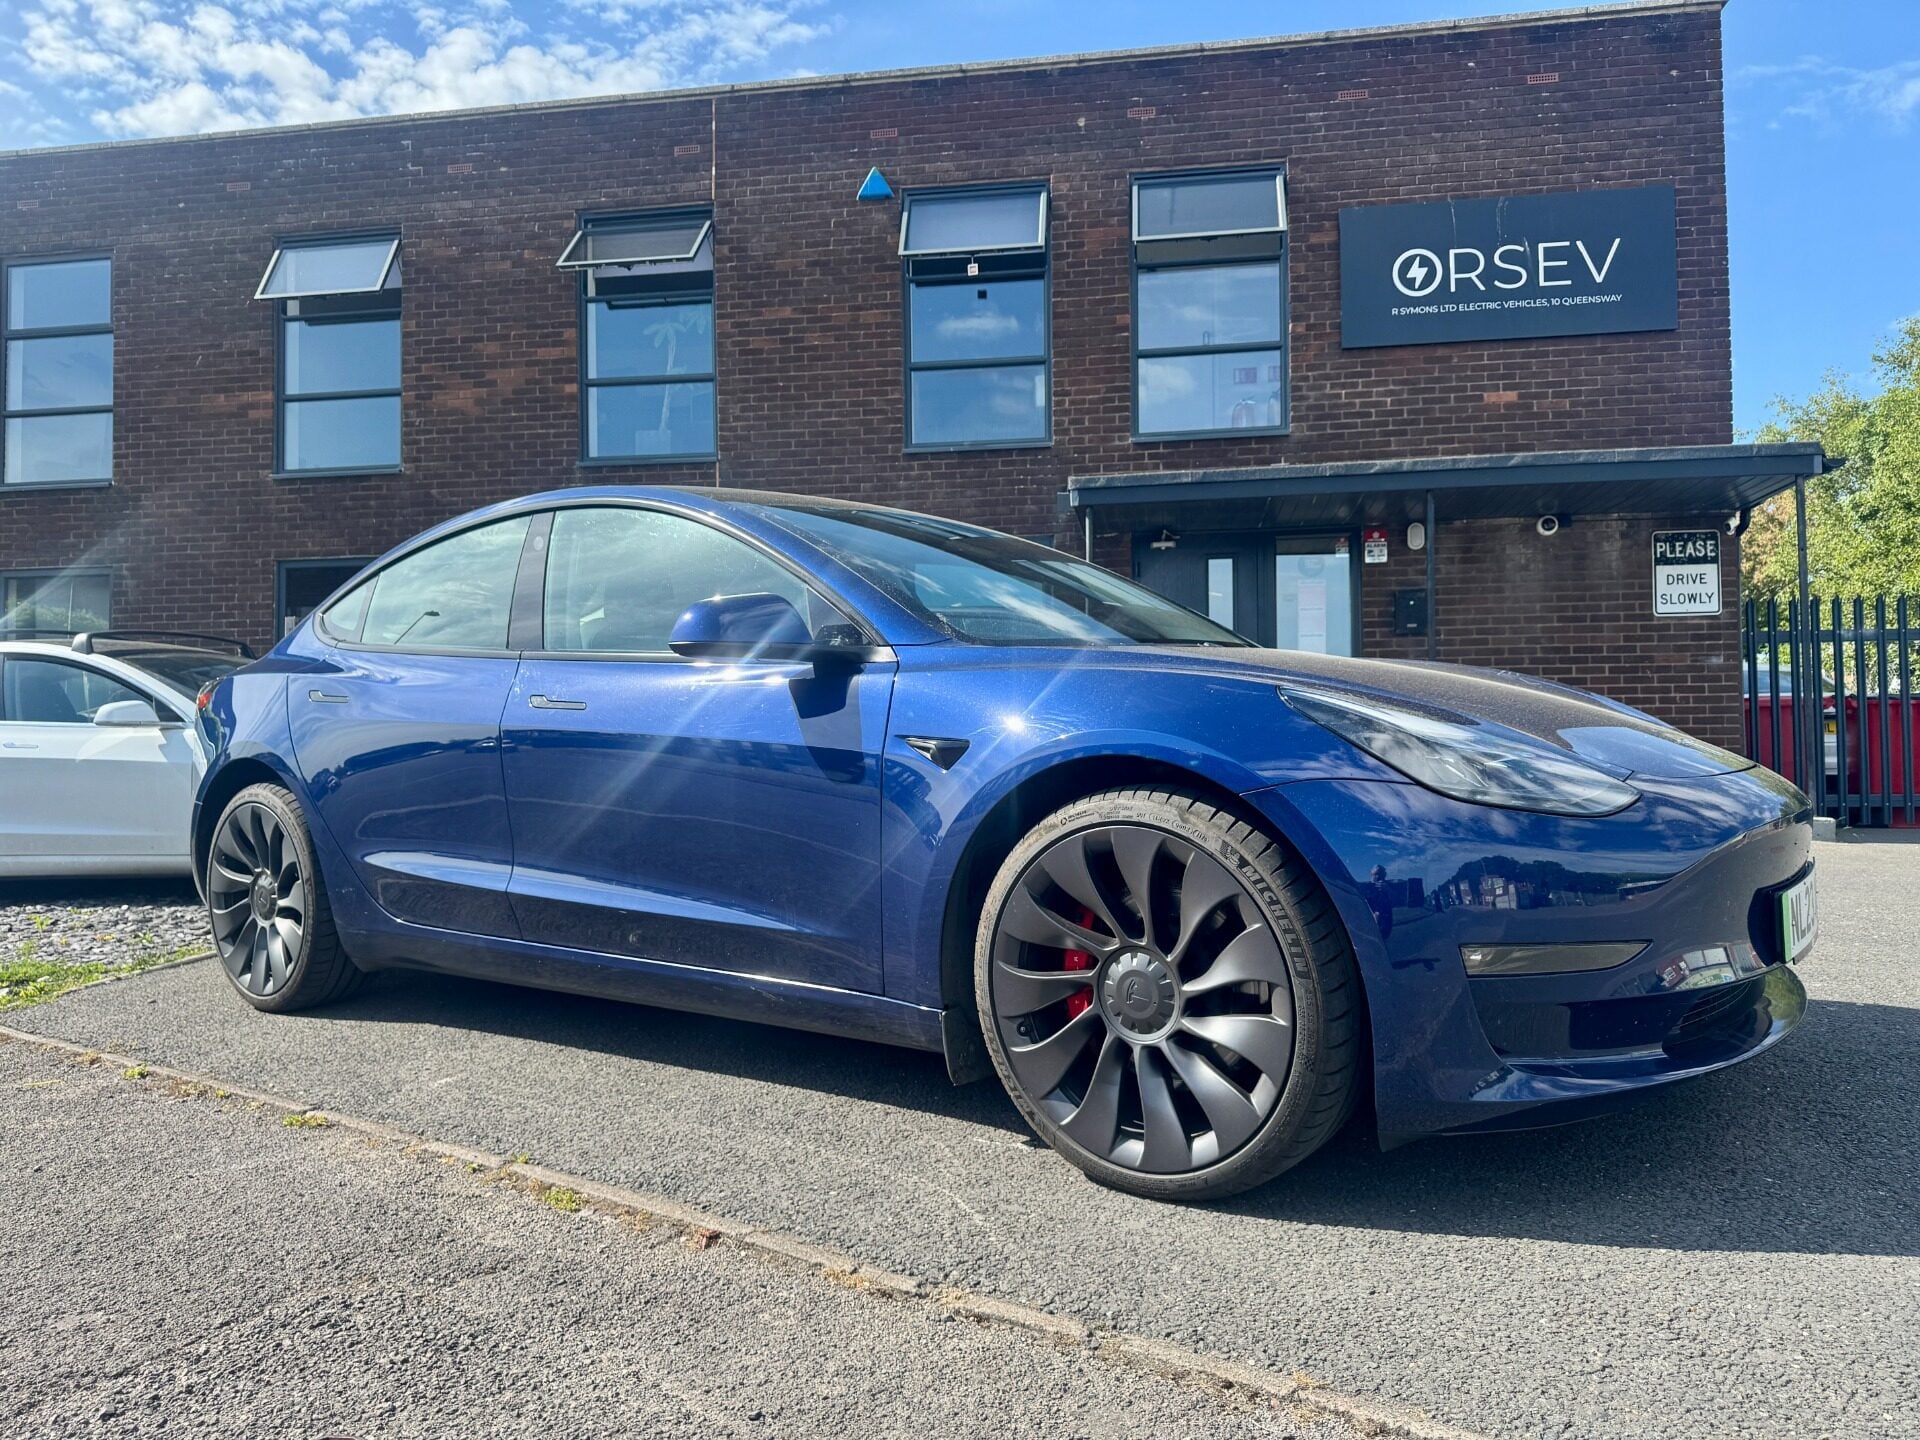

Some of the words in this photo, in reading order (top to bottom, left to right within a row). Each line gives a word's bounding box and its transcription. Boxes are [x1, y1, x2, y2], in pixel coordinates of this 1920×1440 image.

[1391, 307, 1399, 316] R
[1400, 305, 1439, 315] SYMONS
[1440, 303, 1457, 313] LTD
[1459, 301, 1502, 311] ELECTRIC
[1503, 298, 1550, 309] VEHICLES,
[1551, 298, 1561, 306] 10
[1562, 294, 1623, 306] QUEENSWAY
[1656, 540, 1716, 558] PLEASE
[1666, 573, 1708, 586] DRIVE
[1660, 592, 1715, 605] SLOWLY
[1241, 864, 1309, 973] MICHELIN
